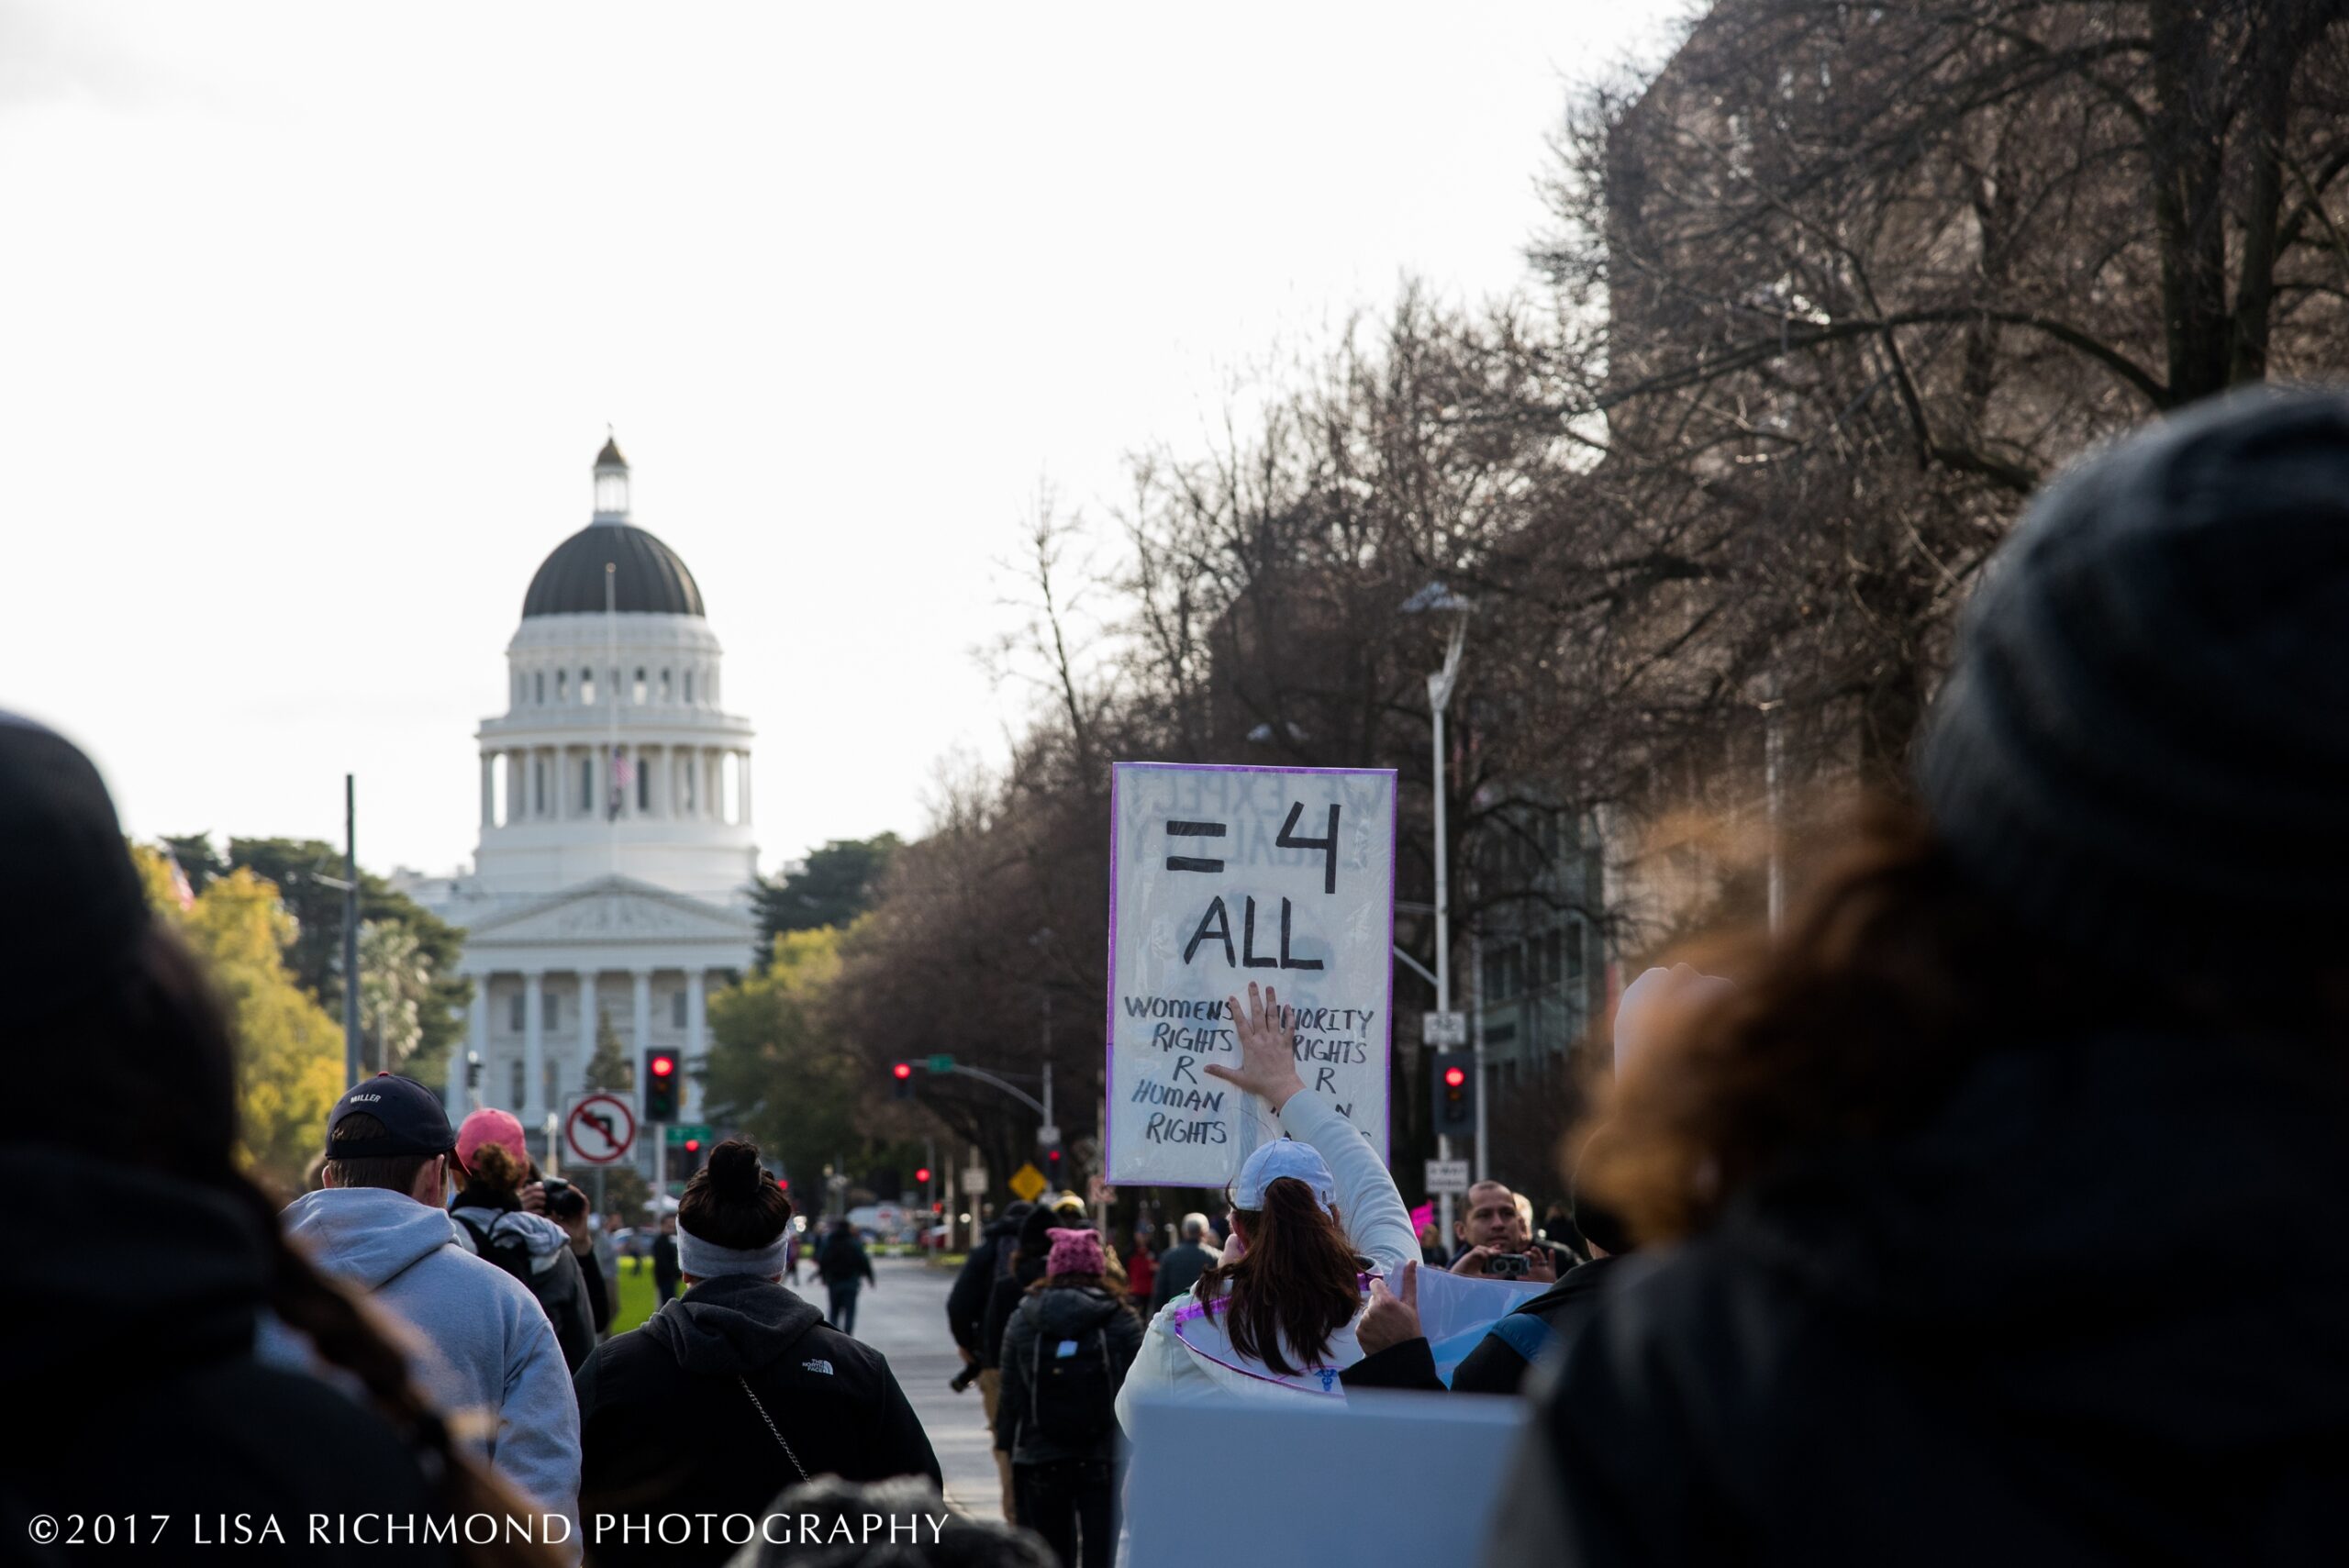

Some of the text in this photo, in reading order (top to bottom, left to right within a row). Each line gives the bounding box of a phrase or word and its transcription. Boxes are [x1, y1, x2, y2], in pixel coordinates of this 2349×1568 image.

[1275, 800, 1341, 895] 4
[1183, 895, 1324, 971] ALL
[1124, 995, 1234, 1021] WOMENS
[1152, 1022, 1234, 1053] RIGHTS
[1292, 1034, 1367, 1064] RIGHTS
[1172, 1055, 1198, 1084] R
[1315, 1067, 1337, 1094] R
[350, 1093, 382, 1105] MILLER
[1130, 1078, 1225, 1113] HUMAN
[1145, 1112, 1228, 1145] RIGHTS
